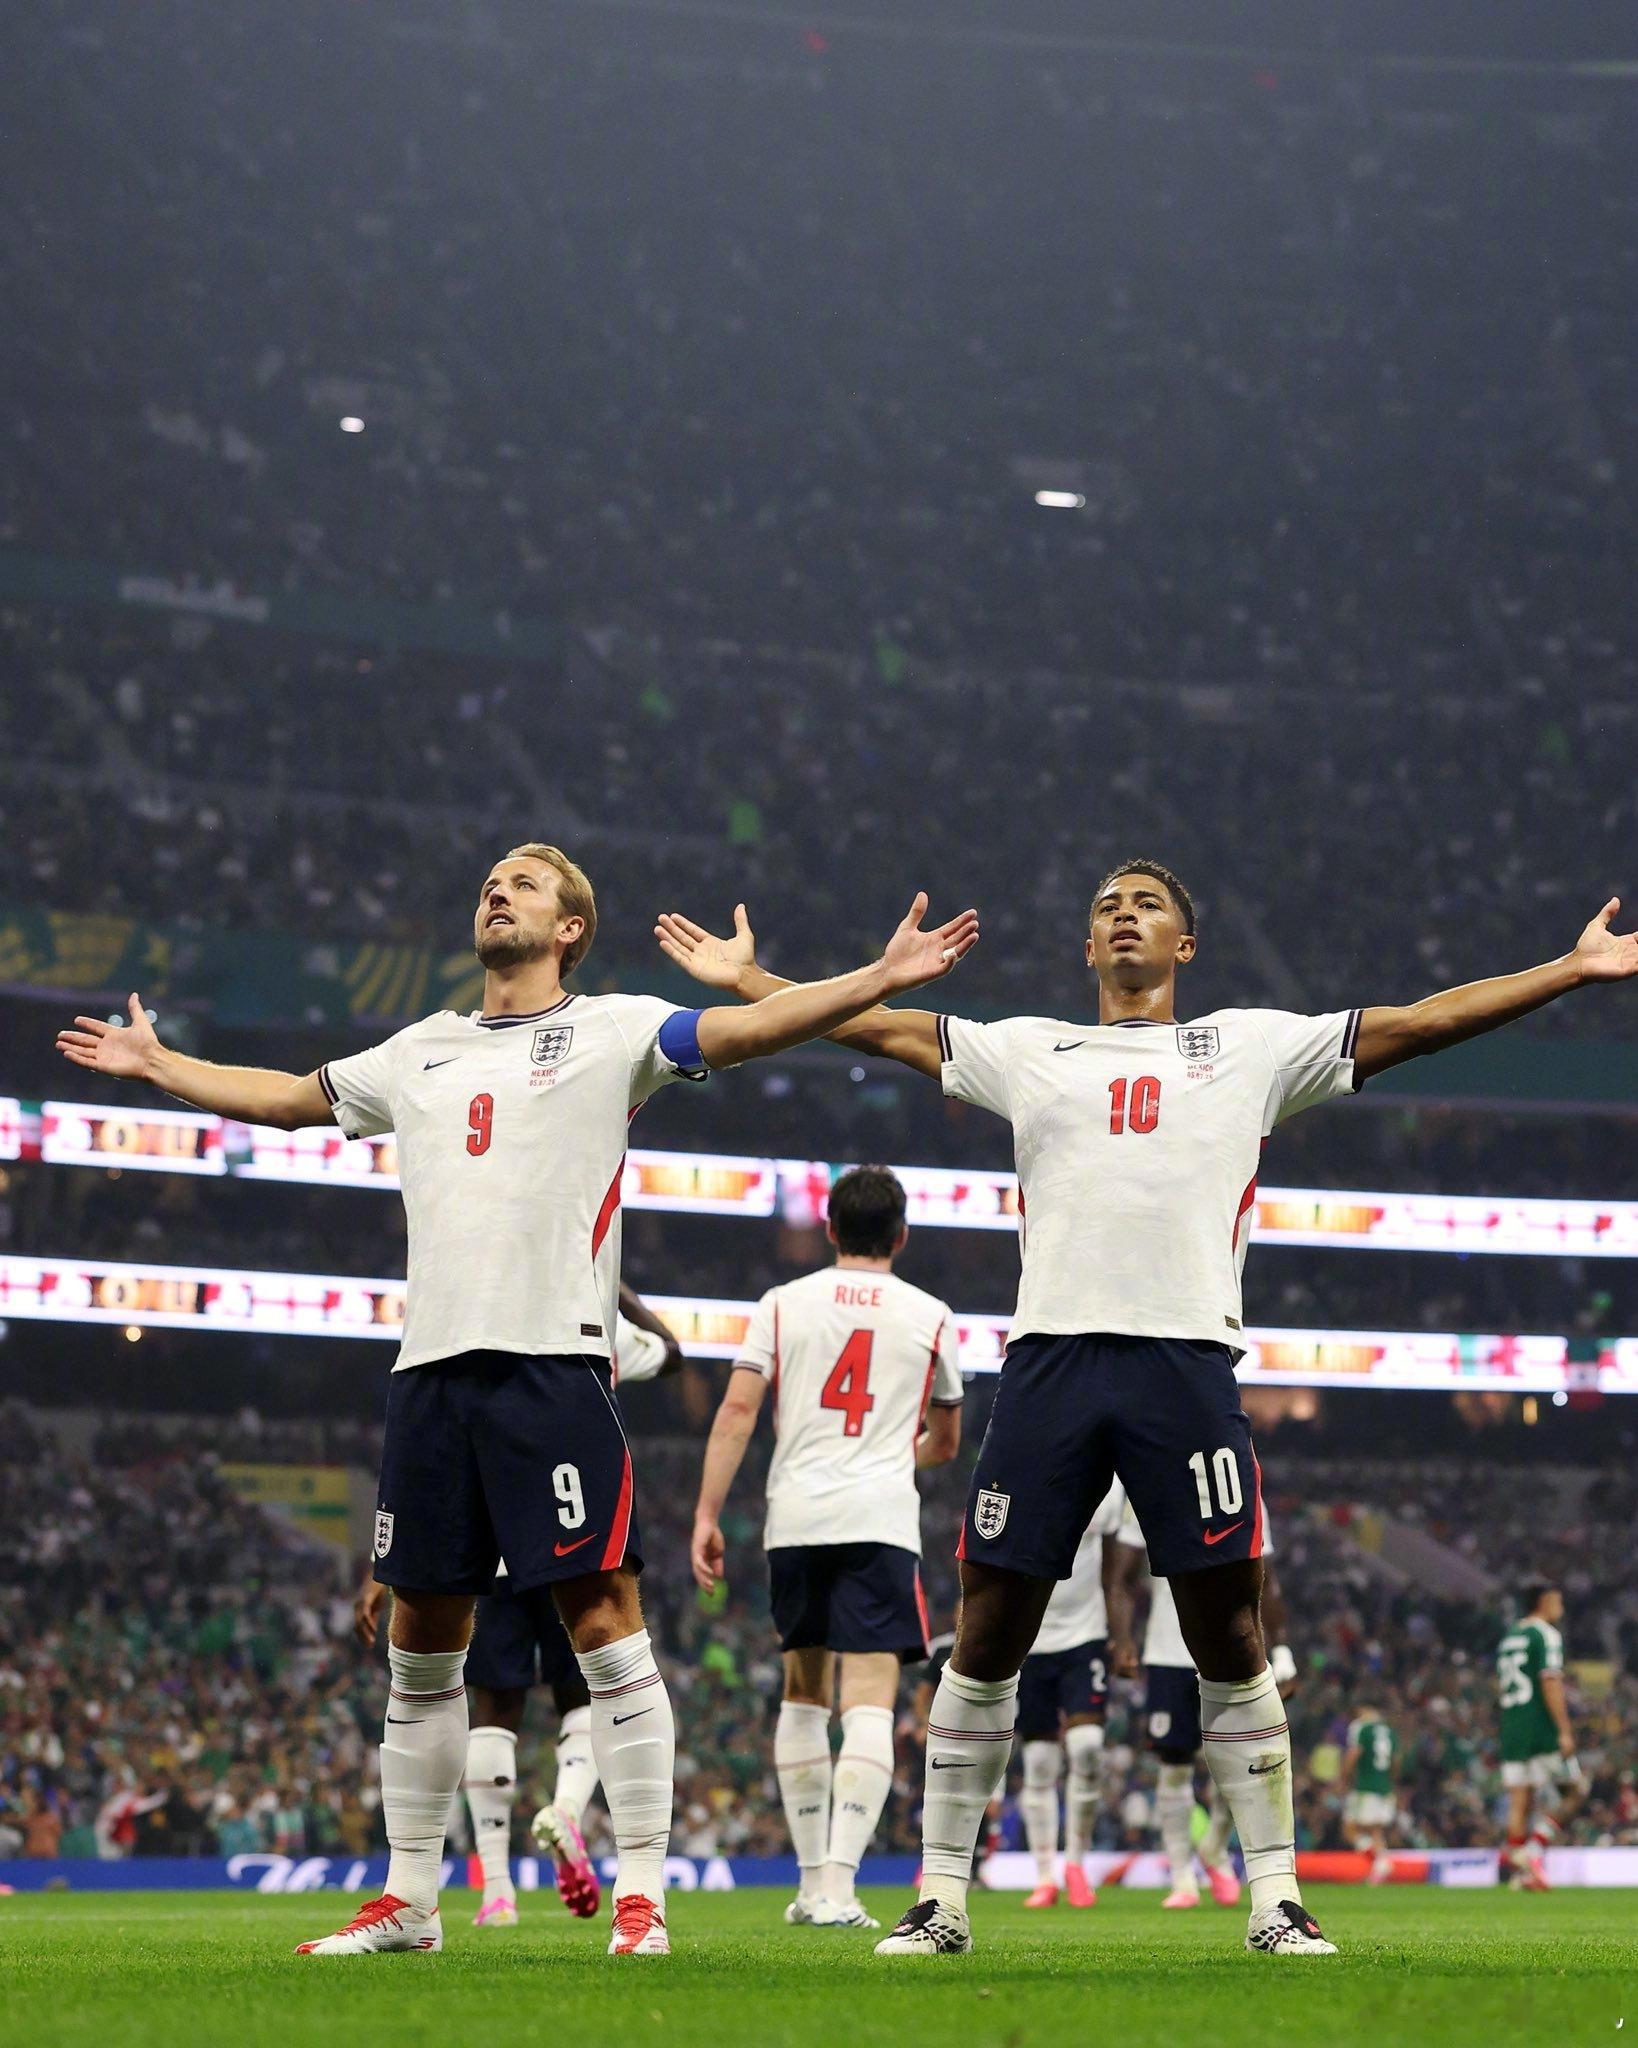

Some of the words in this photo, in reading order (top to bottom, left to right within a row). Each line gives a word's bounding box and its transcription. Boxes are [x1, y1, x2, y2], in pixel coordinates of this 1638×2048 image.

[530, 1069, 559, 1078] MEXICO
[466, 1093, 494, 1157] 9
[1109, 1076, 1162, 1135] 10
[835, 1285, 883, 1306] RICE
[820, 1329, 874, 1437] 4
[552, 1463, 587, 1529] 9
[1188, 1447, 1243, 1519] 10
[1089, 1657, 1107, 1692] 2
